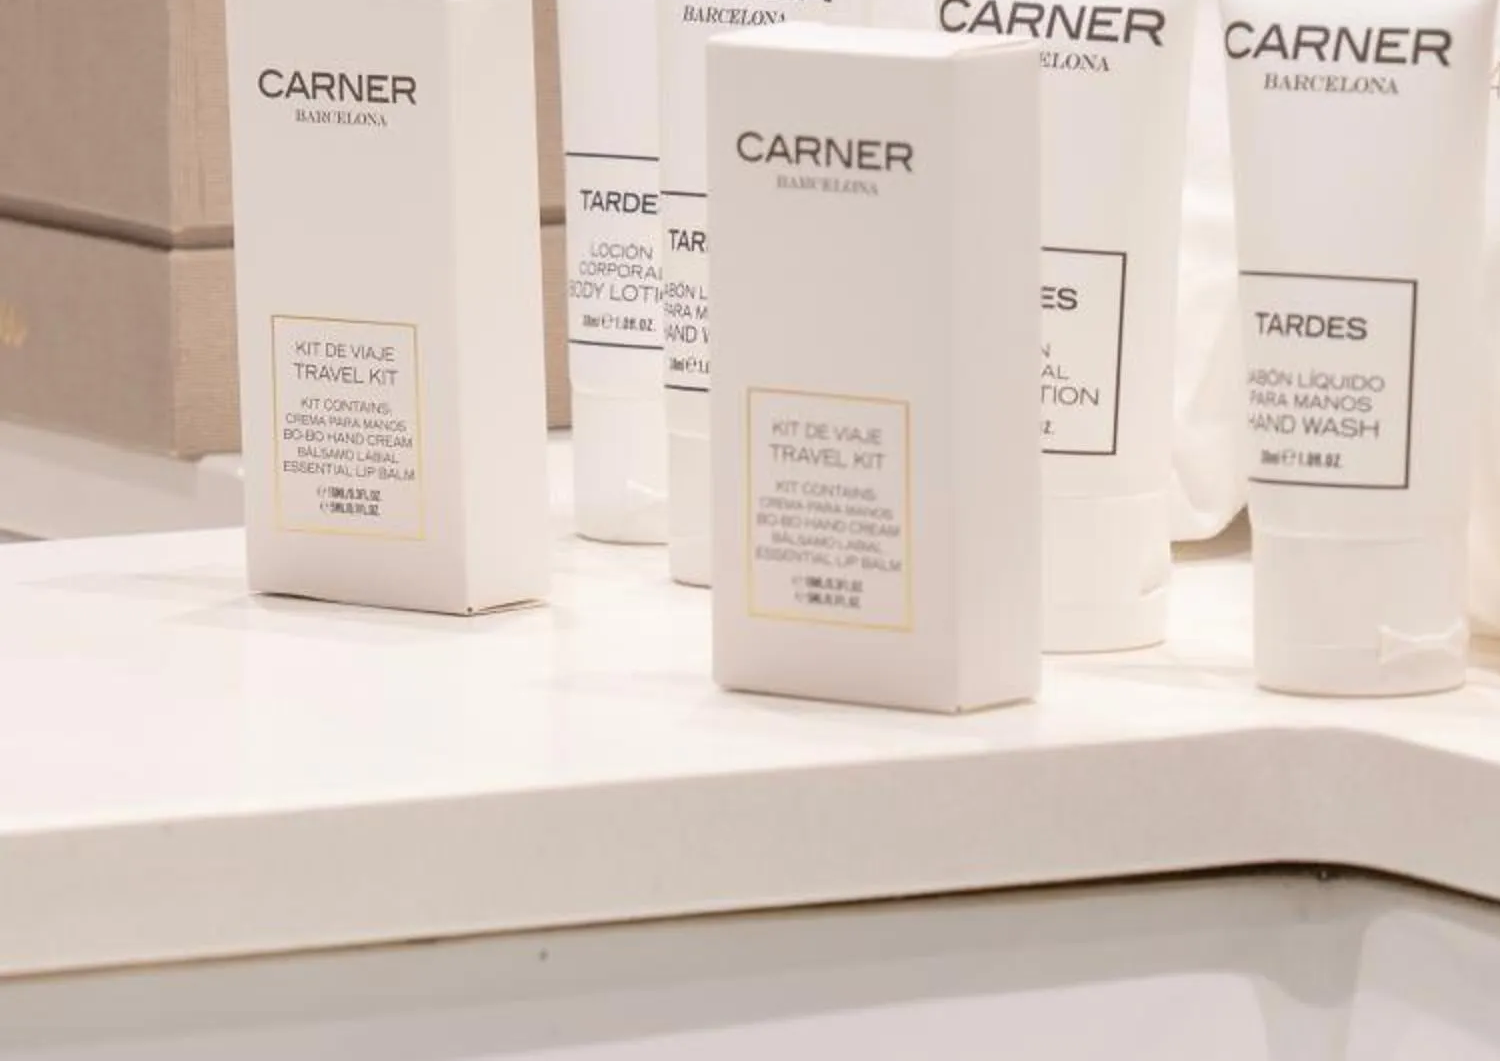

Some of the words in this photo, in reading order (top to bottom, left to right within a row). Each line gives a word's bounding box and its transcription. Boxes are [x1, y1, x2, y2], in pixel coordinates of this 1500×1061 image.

[683, 5, 786, 26] BARCELONA
[1224, 20, 1453, 67] CARNER
[258, 68, 417, 105] CARNER
[1264, 72, 1399, 95] BARCELONA
[295, 109, 388, 127] BARCELONA
[736, 130, 914, 172] CARNER
[580, 189, 659, 215] TARDE
[668, 228, 709, 253] TAR
[609, 284, 663, 303] LOTI
[1255, 312, 1367, 341] TARDES
[295, 341, 321, 357] KIT
[325, 343, 347, 358] DE
[350, 345, 395, 362] VIAJE
[293, 362, 364, 384] TRAVEL
[368, 369, 399, 386] KIT
[1297, 369, 1385, 393] LÍQUIDO
[301, 397, 321, 410] KIT
[1294, 394, 1373, 413] MANOS
[285, 412, 326, 427] CREMA
[329, 415, 361, 429] PARA
[363, 418, 407, 432] MANOS
[772, 420, 800, 437] KIT
[804, 422, 830, 440] DE
[834, 425, 882, 445] VIAJE
[1302, 416, 1380, 438] WASH
[327, 431, 364, 445] HAND
[367, 434, 413, 449] CREAM
[357, 450, 399, 464] LABIAL
[769, 442, 847, 469] TRAVEL
[853, 451, 886, 470] KIT
[283, 460, 353, 477] ESSENTIAL
[356, 465, 375, 478] LIP
[378, 467, 416, 482] BALM
